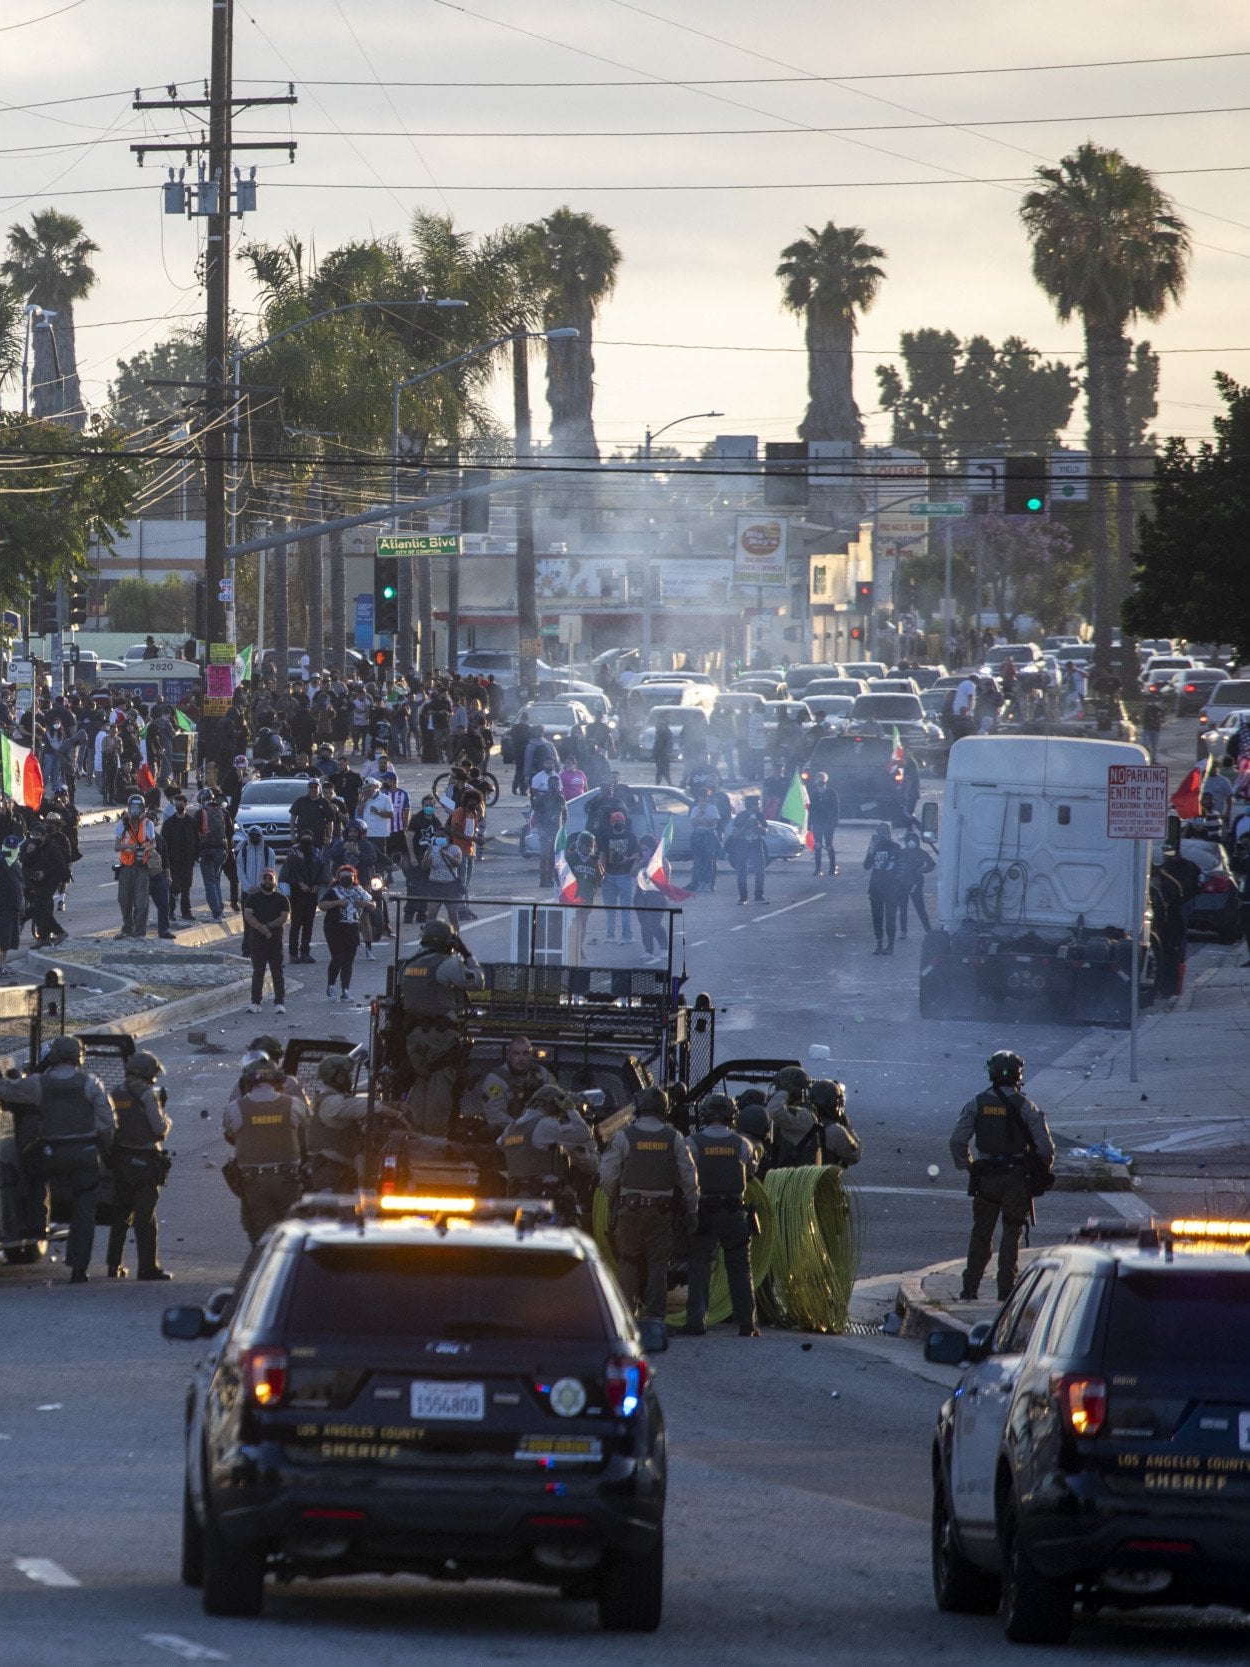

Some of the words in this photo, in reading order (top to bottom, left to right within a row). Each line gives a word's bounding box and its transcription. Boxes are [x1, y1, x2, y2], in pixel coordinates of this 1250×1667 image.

[380, 538, 426, 549] Atlantic
[429, 537, 456, 548] Blvd
[885, 548, 913, 558] Kng
[150, 663, 173, 671] 2820
[1110, 768, 1125, 783] NO
[1126, 769, 1166, 783] PARKING
[1110, 786, 1141, 800] ENTIRE
[1145, 787, 1165, 800] CITY
[983, 1106, 1007, 1115] SHERI
[251, 1115, 282, 1125] SHERIFF
[636, 1141, 668, 1150] SHERIFF
[704, 1146, 735, 1156] SHERIFF
[296, 1423, 318, 1436] LOS
[322, 1424, 375, 1438] ANGELES
[380, 1426, 426, 1440] COUNTY
[320, 1442, 400, 1458] SHERIFF
[1118, 1453, 1139, 1467] LOS
[1146, 1454, 1200, 1469] ANGELES
[1145, 1473, 1228, 1490] SHERIFF
